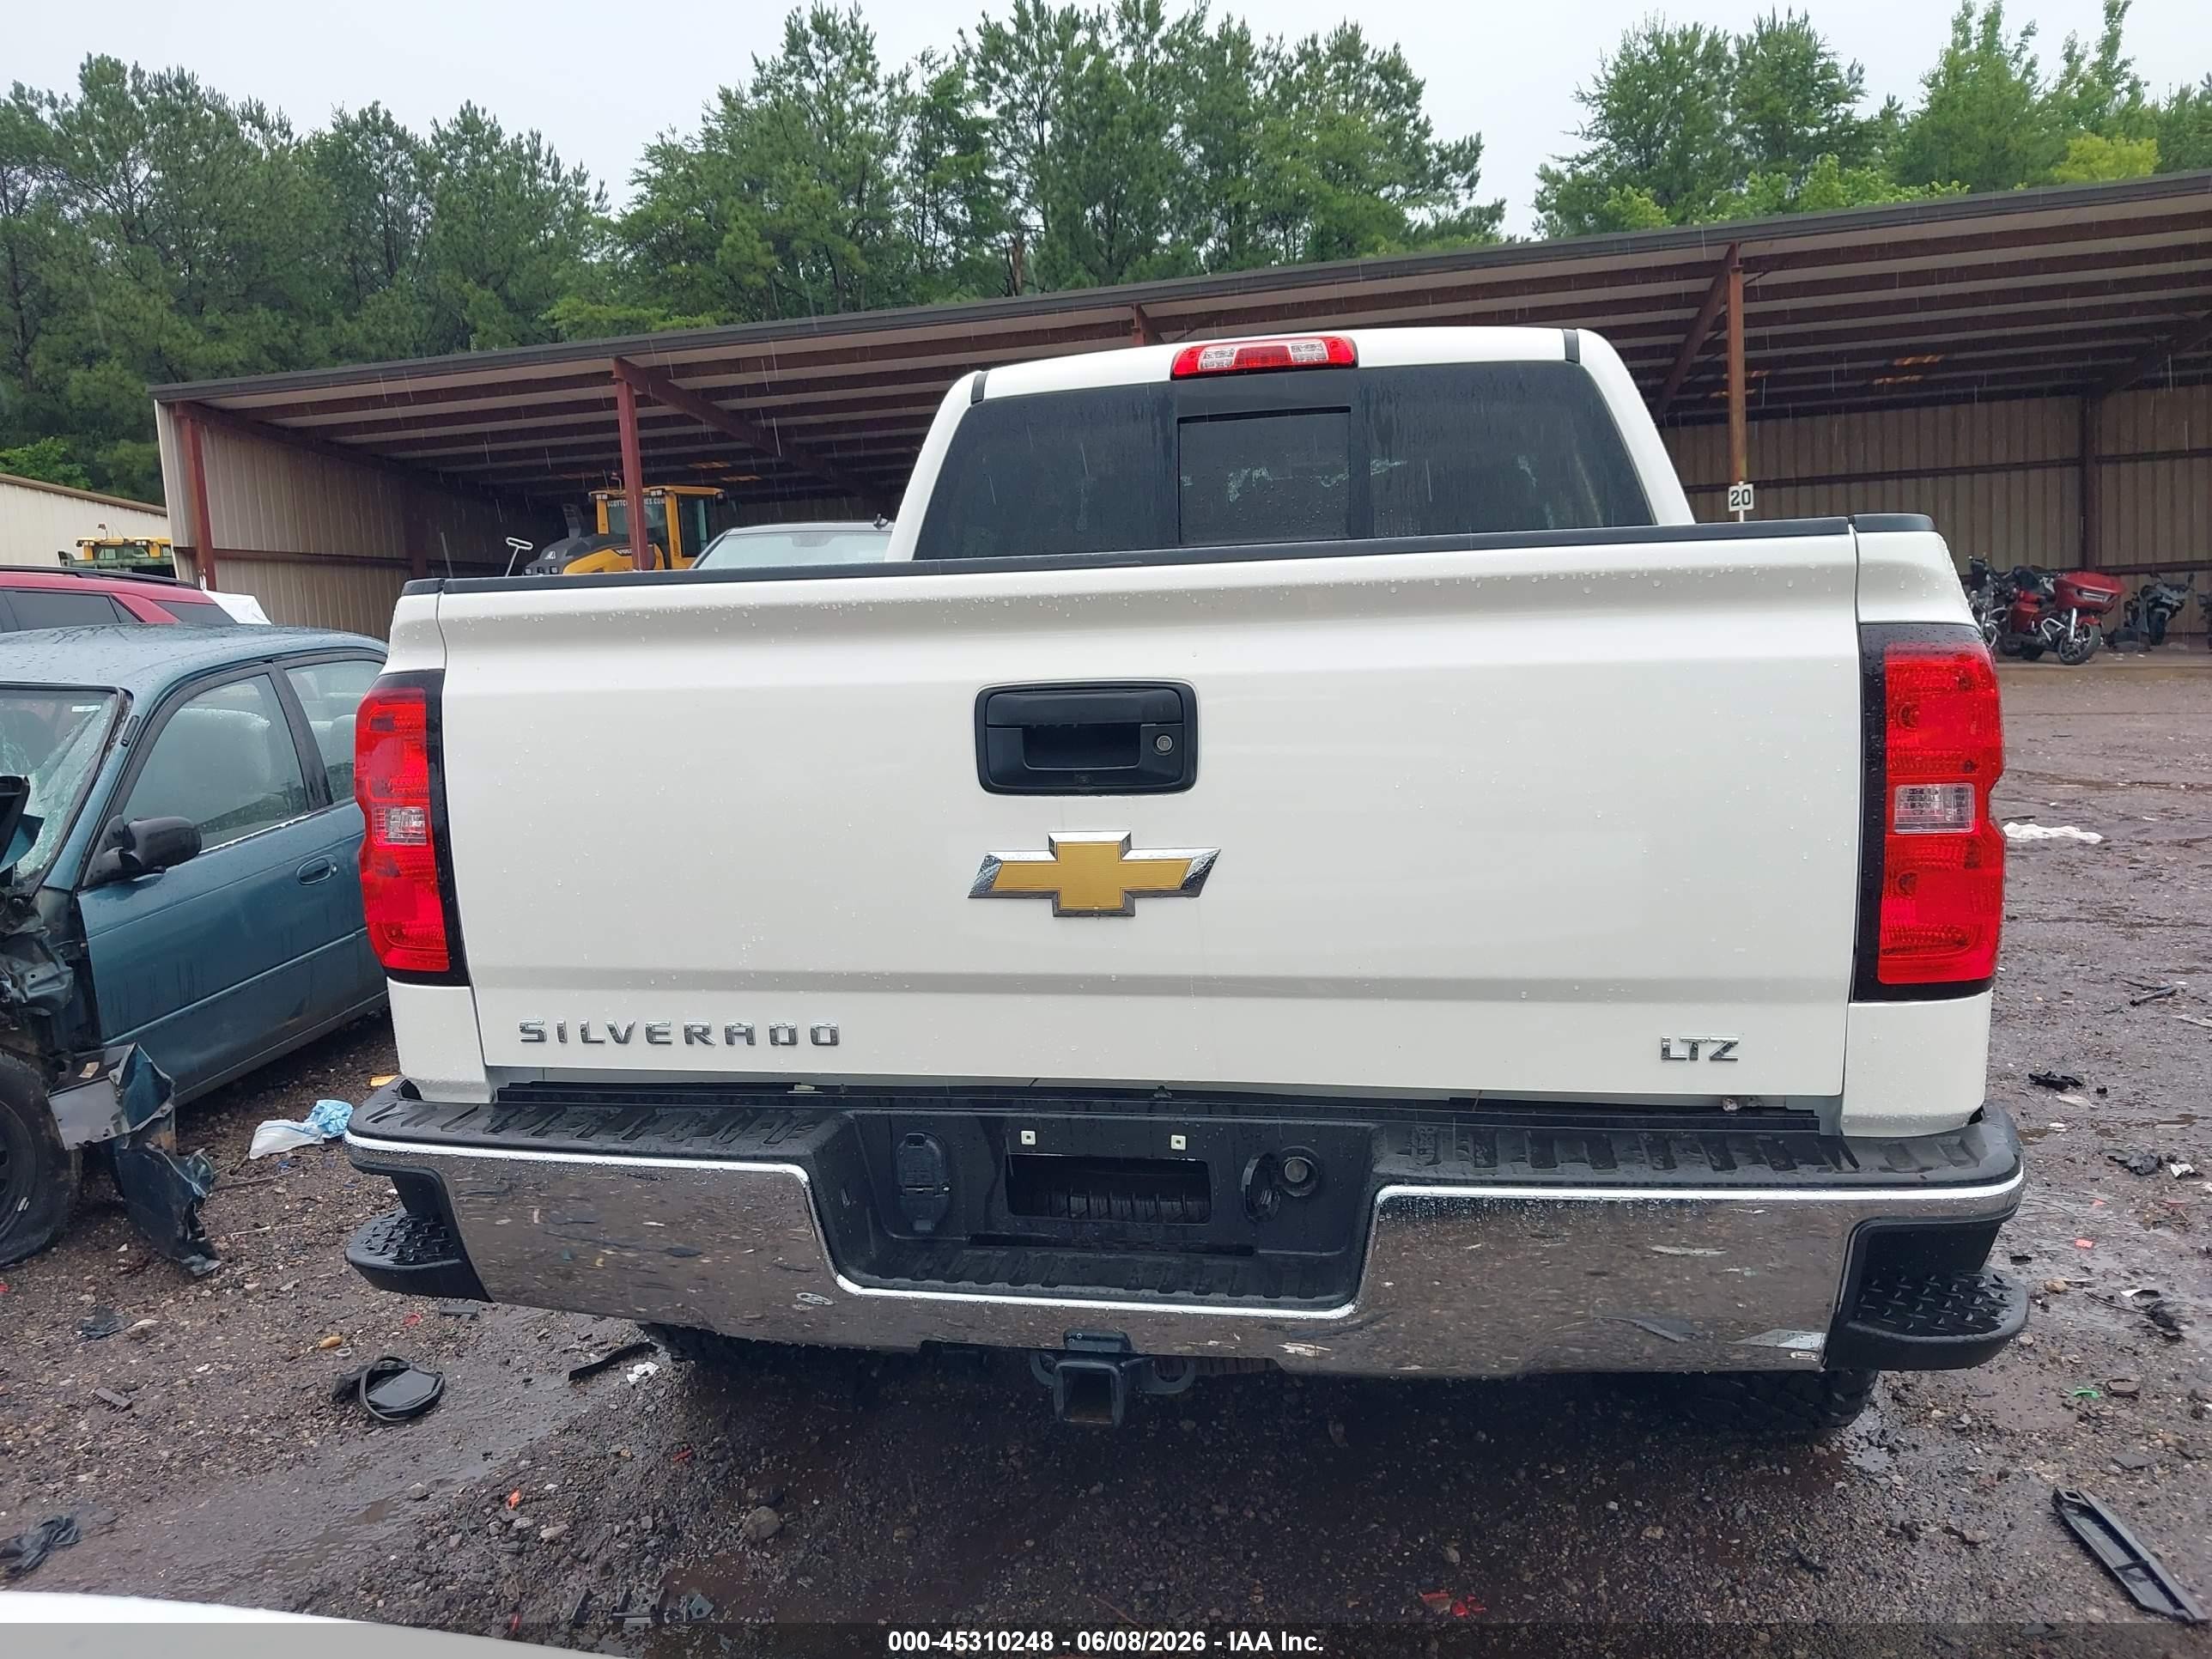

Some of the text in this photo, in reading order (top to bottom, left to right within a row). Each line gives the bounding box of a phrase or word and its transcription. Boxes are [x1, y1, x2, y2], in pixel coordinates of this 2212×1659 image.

[1730, 489, 1752, 507] 20
[519, 1019, 841, 1046] SILVERADO
[1661, 1036, 1739, 1061] LTZ
